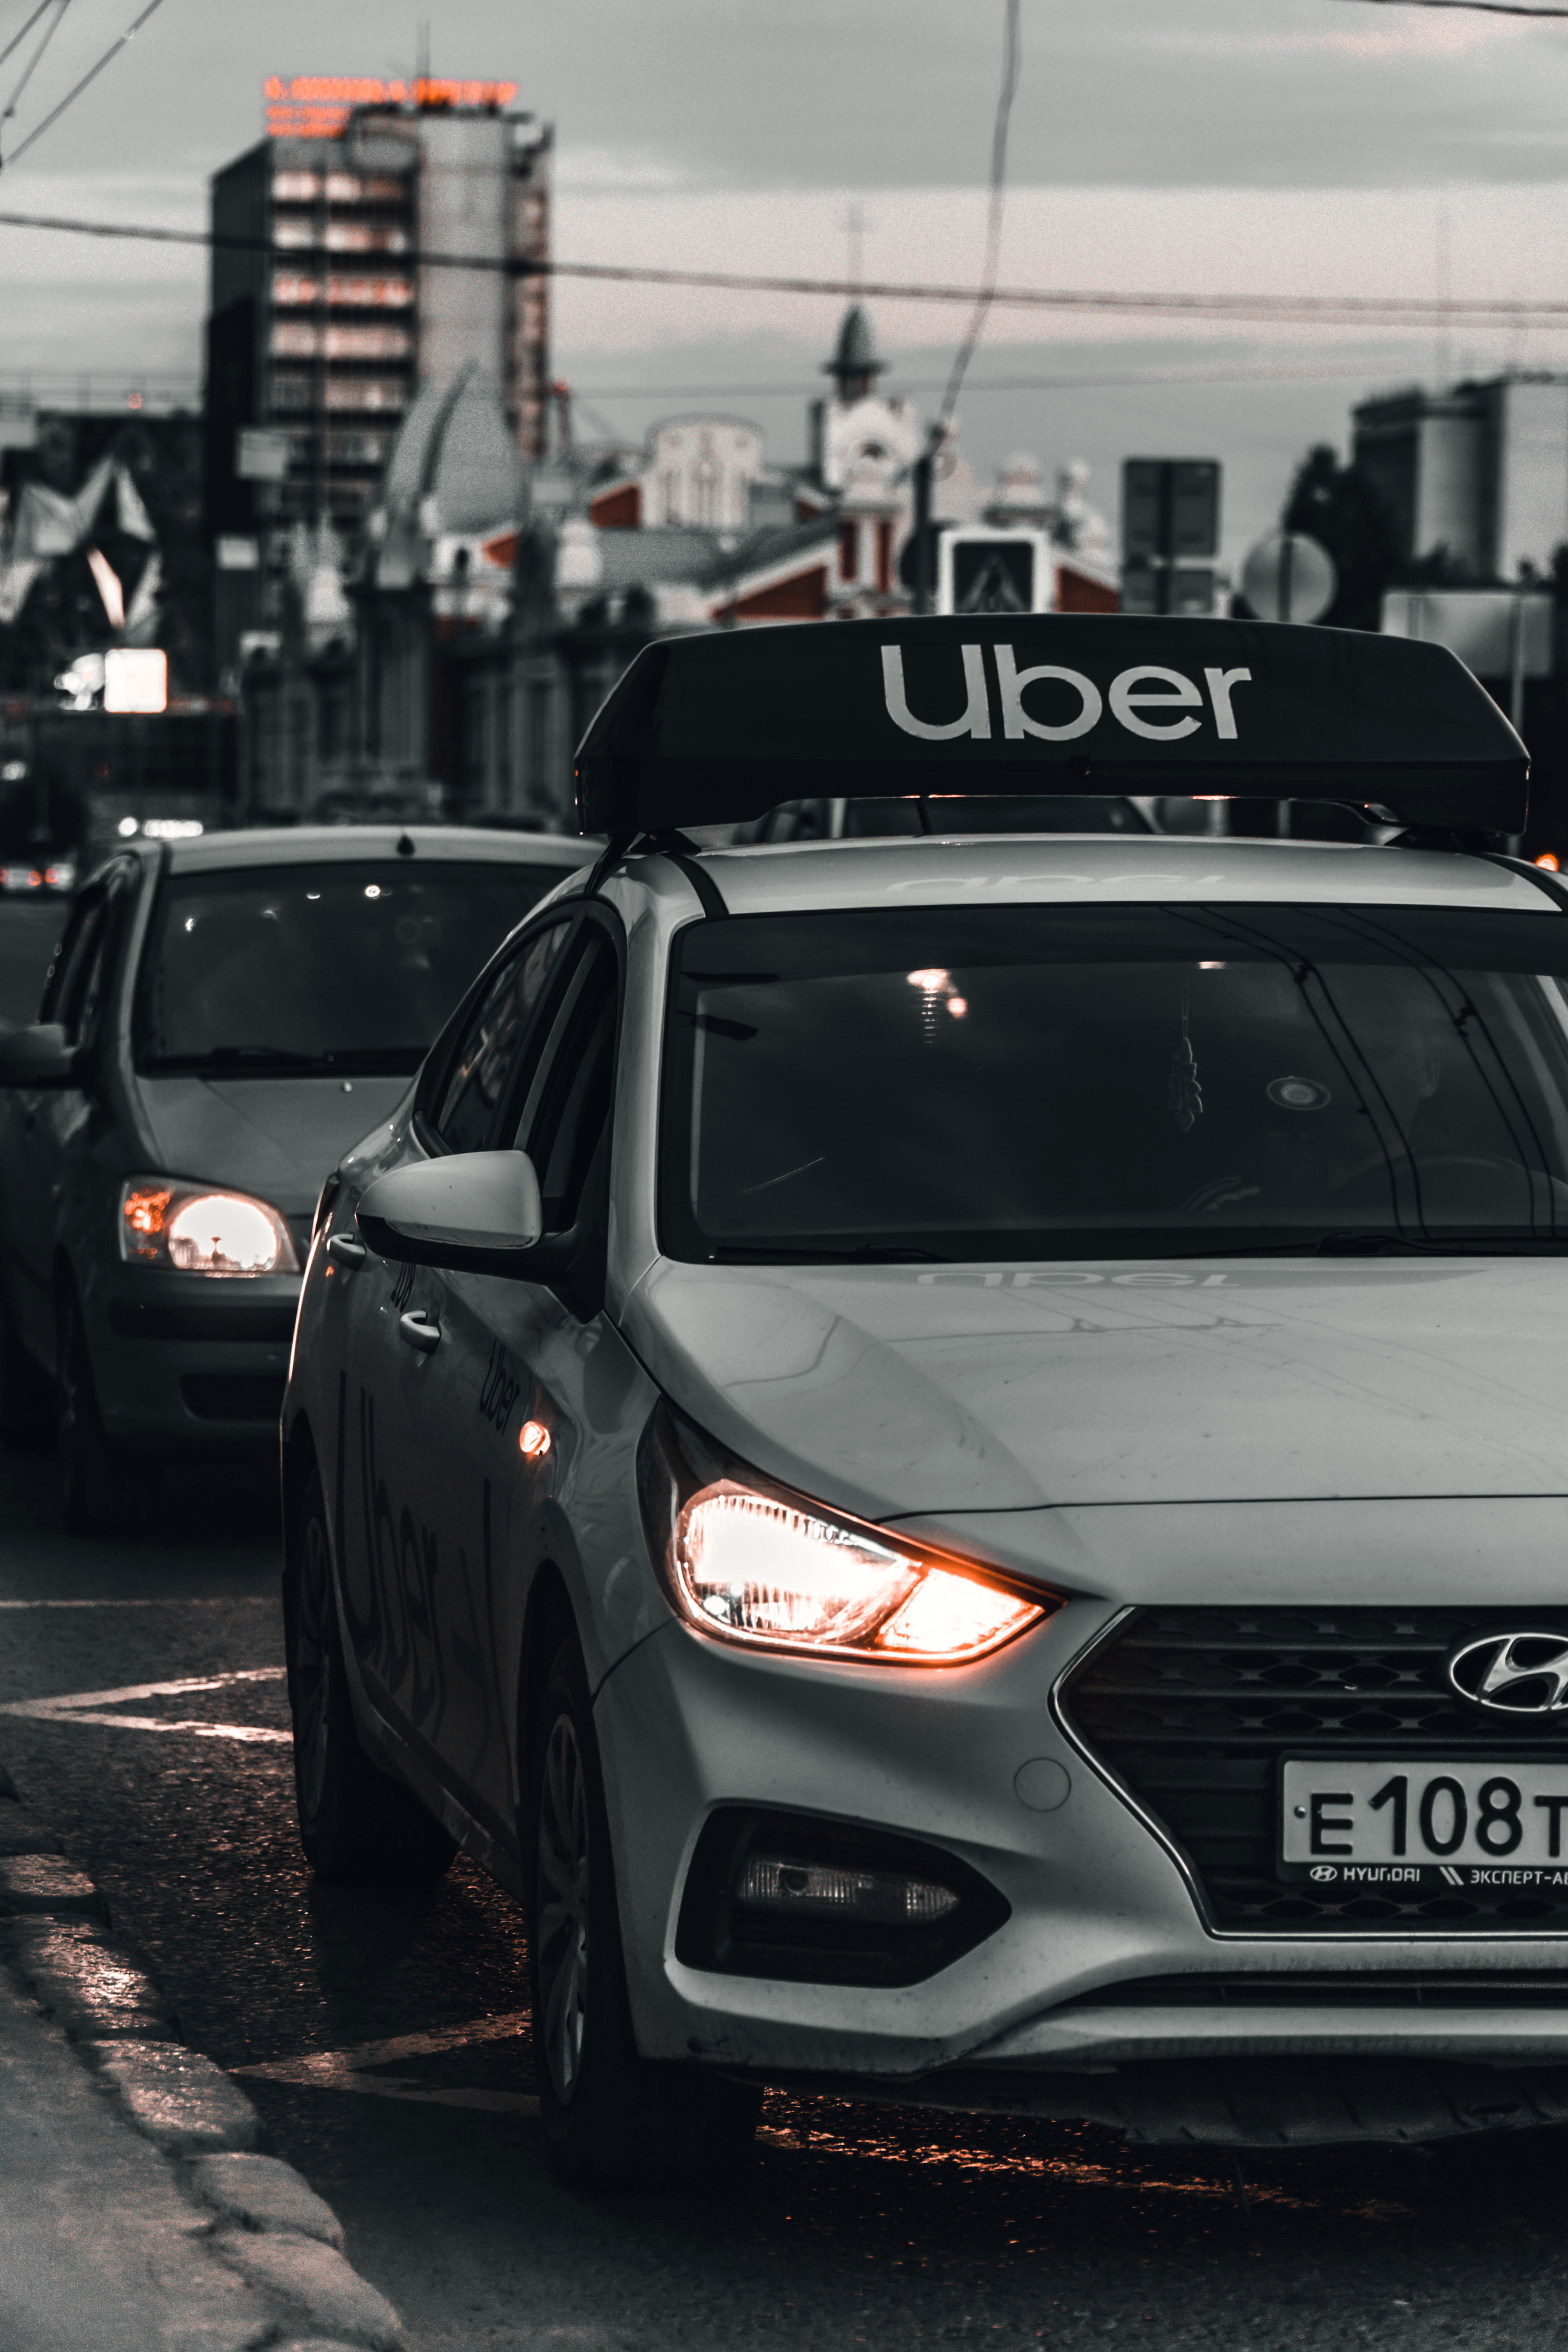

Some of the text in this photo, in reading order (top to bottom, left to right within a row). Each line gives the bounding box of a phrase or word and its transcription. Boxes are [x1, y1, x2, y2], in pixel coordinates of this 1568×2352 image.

[881, 644, 1252, 740] Uber
[479, 1338, 521, 1436] Uber
[335, 1369, 446, 1744] Uber
[1344, 1867, 1420, 1882] HYUNDAI
